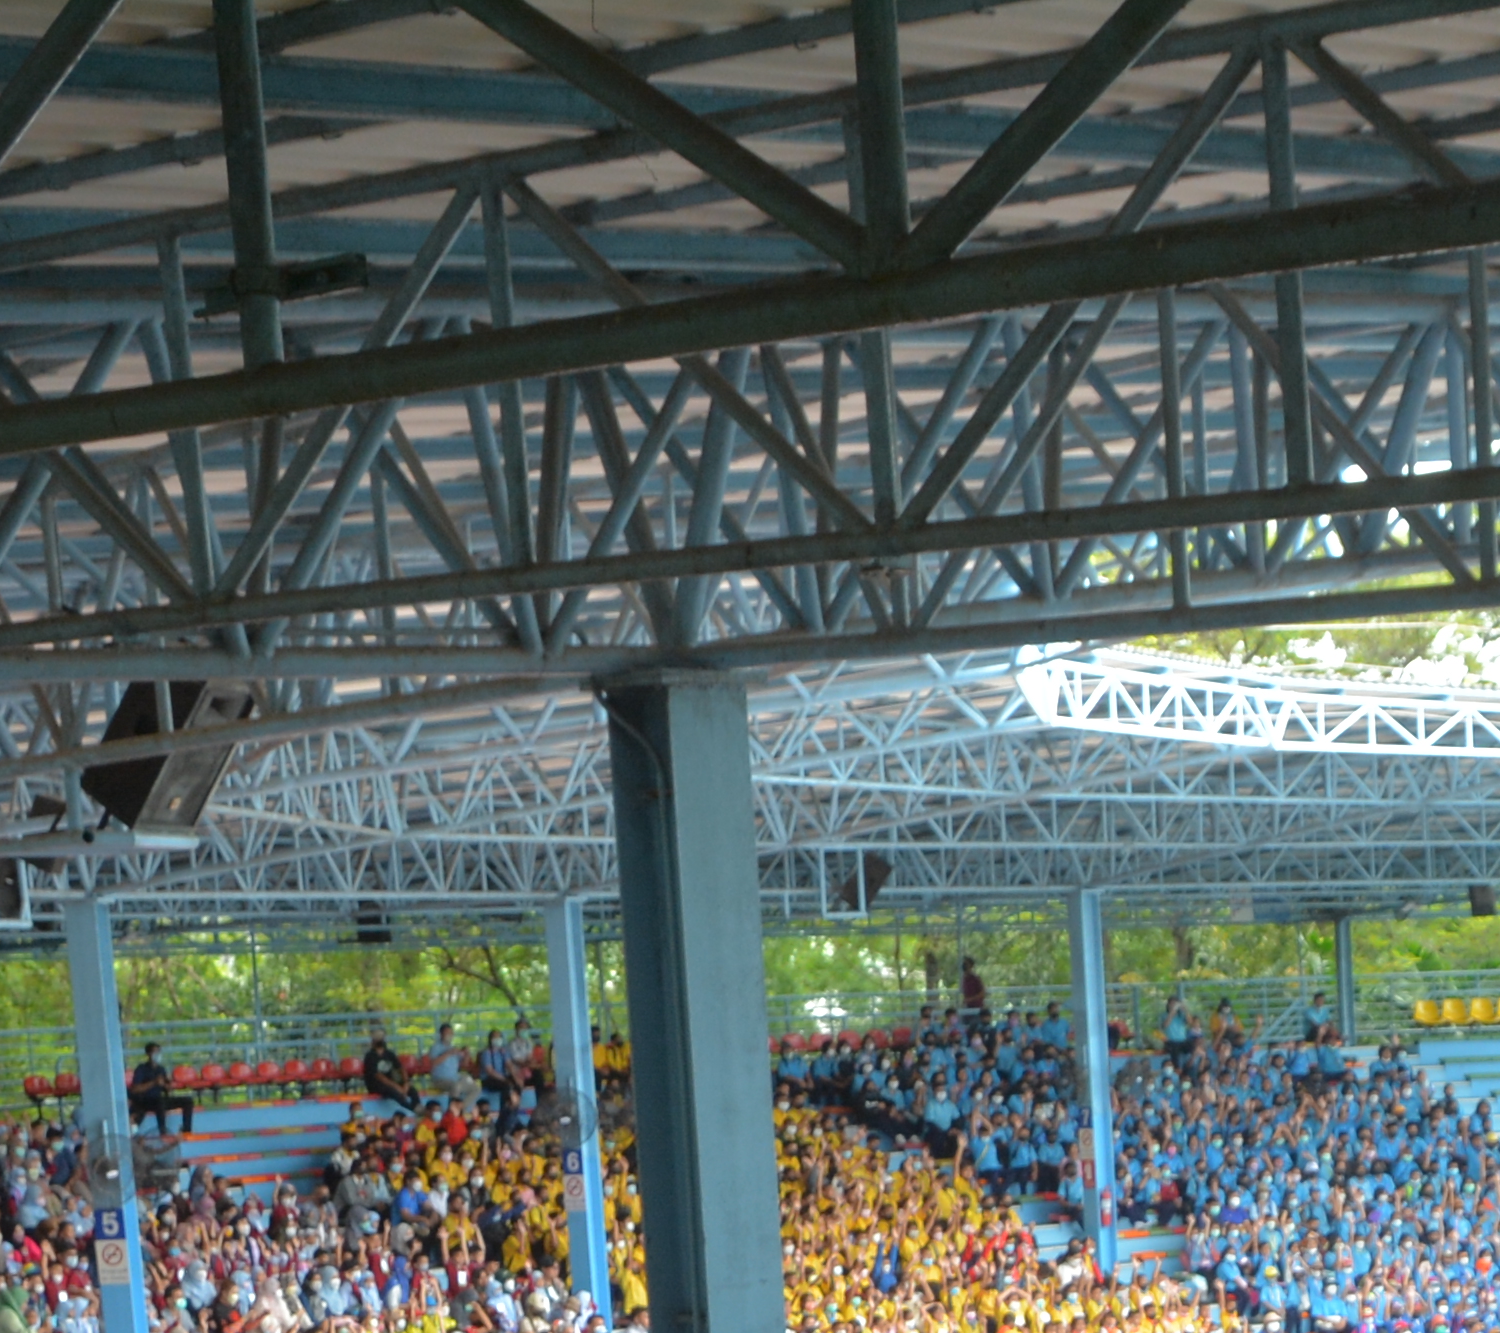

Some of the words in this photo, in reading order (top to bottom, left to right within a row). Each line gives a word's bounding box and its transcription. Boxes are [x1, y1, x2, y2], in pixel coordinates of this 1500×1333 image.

[1081, 1108, 1090, 1126] 7
[566, 1151, 580, 1172] 6
[102, 1211, 119, 1236] 5
